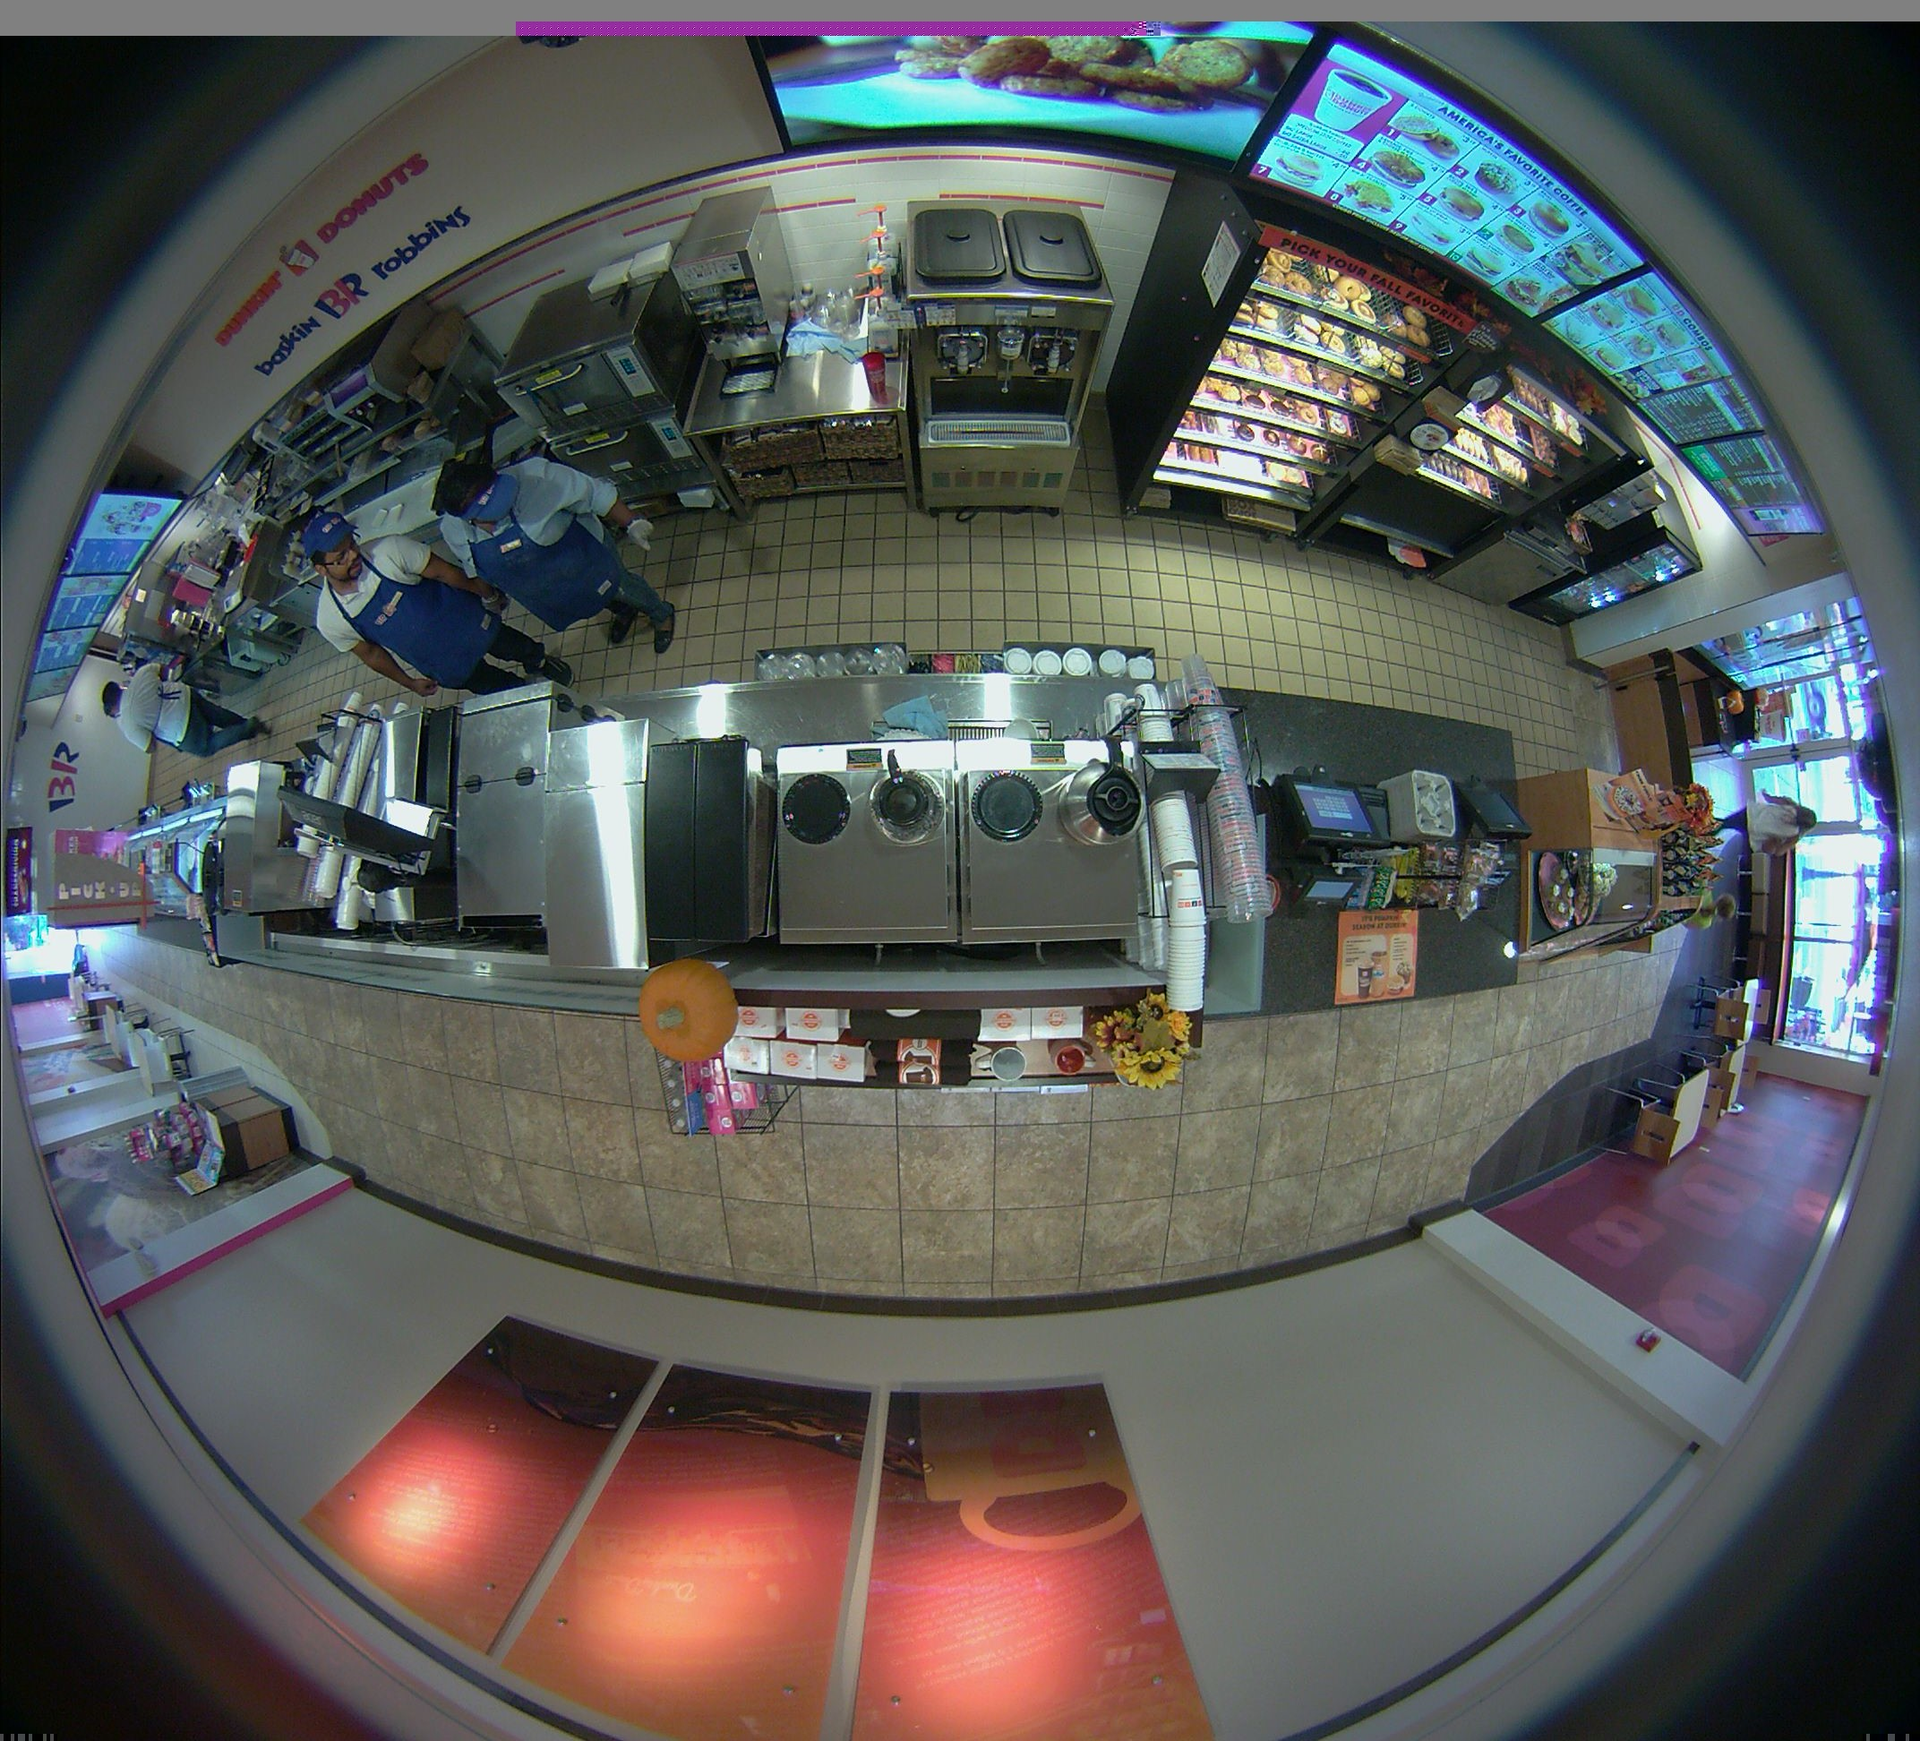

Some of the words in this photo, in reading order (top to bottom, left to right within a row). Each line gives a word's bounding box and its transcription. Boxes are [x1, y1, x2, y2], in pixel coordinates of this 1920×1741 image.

[1438, 106, 1505, 151] AMERICA'S
[1504, 149, 1553, 190] FAVORITE
[1554, 186, 1588, 217] COFFEE
[1455, 168, 1464, 176] 2
[215, 270, 282, 347] DUNKIN'
[317, 153, 429, 244] DONUTS
[1280, 238, 1321, 259] PICK
[1326, 252, 1367, 283] YOUR
[1370, 274, 1402, 296] FALL
[314, 273, 370, 320] BR
[1683, 317, 1713, 352] COMBOS
[48, 742, 79, 813] BR
[59, 881, 142, 900] PICK-UP
